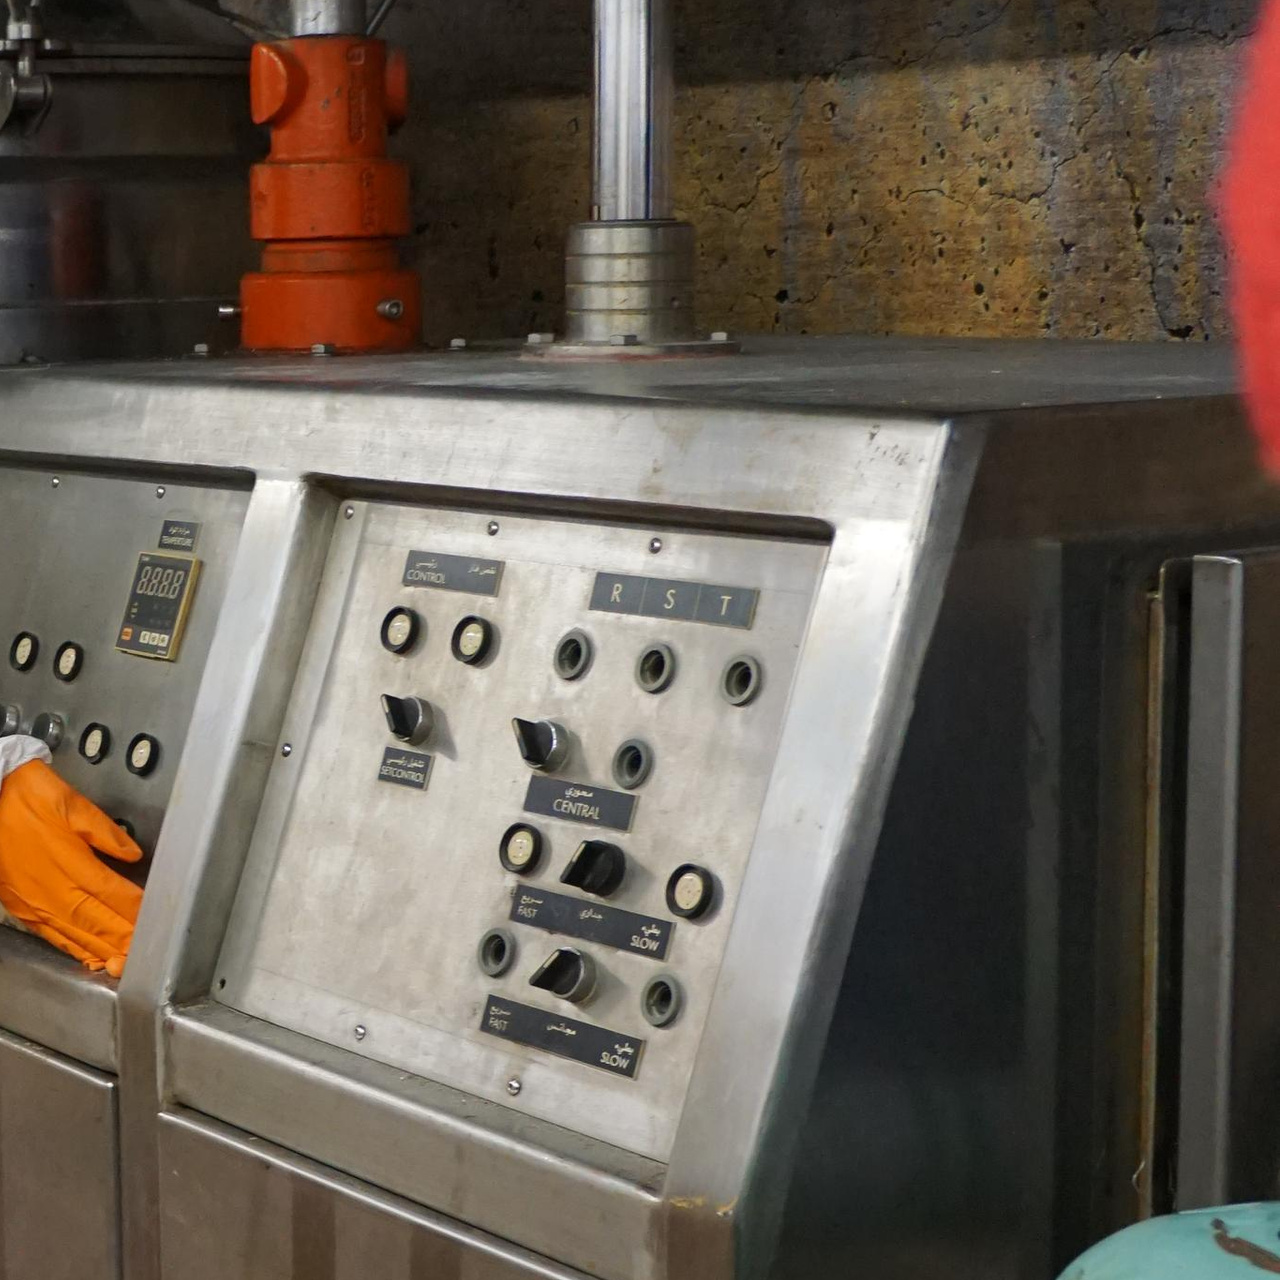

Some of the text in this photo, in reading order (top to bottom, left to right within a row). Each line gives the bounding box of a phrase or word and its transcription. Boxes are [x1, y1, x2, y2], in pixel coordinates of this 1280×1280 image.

[406, 569, 446, 584] CONTROL
[610, 583, 623, 603] R
[663, 589, 676, 609] S
[720, 595, 732, 616] T
[552, 799, 600, 820] CENTRAL
[517, 905, 538, 918] FAST
[630, 934, 660, 951] SLOW
[489, 1017, 509, 1031] FAST
[599, 1051, 630, 1069] SLOW
